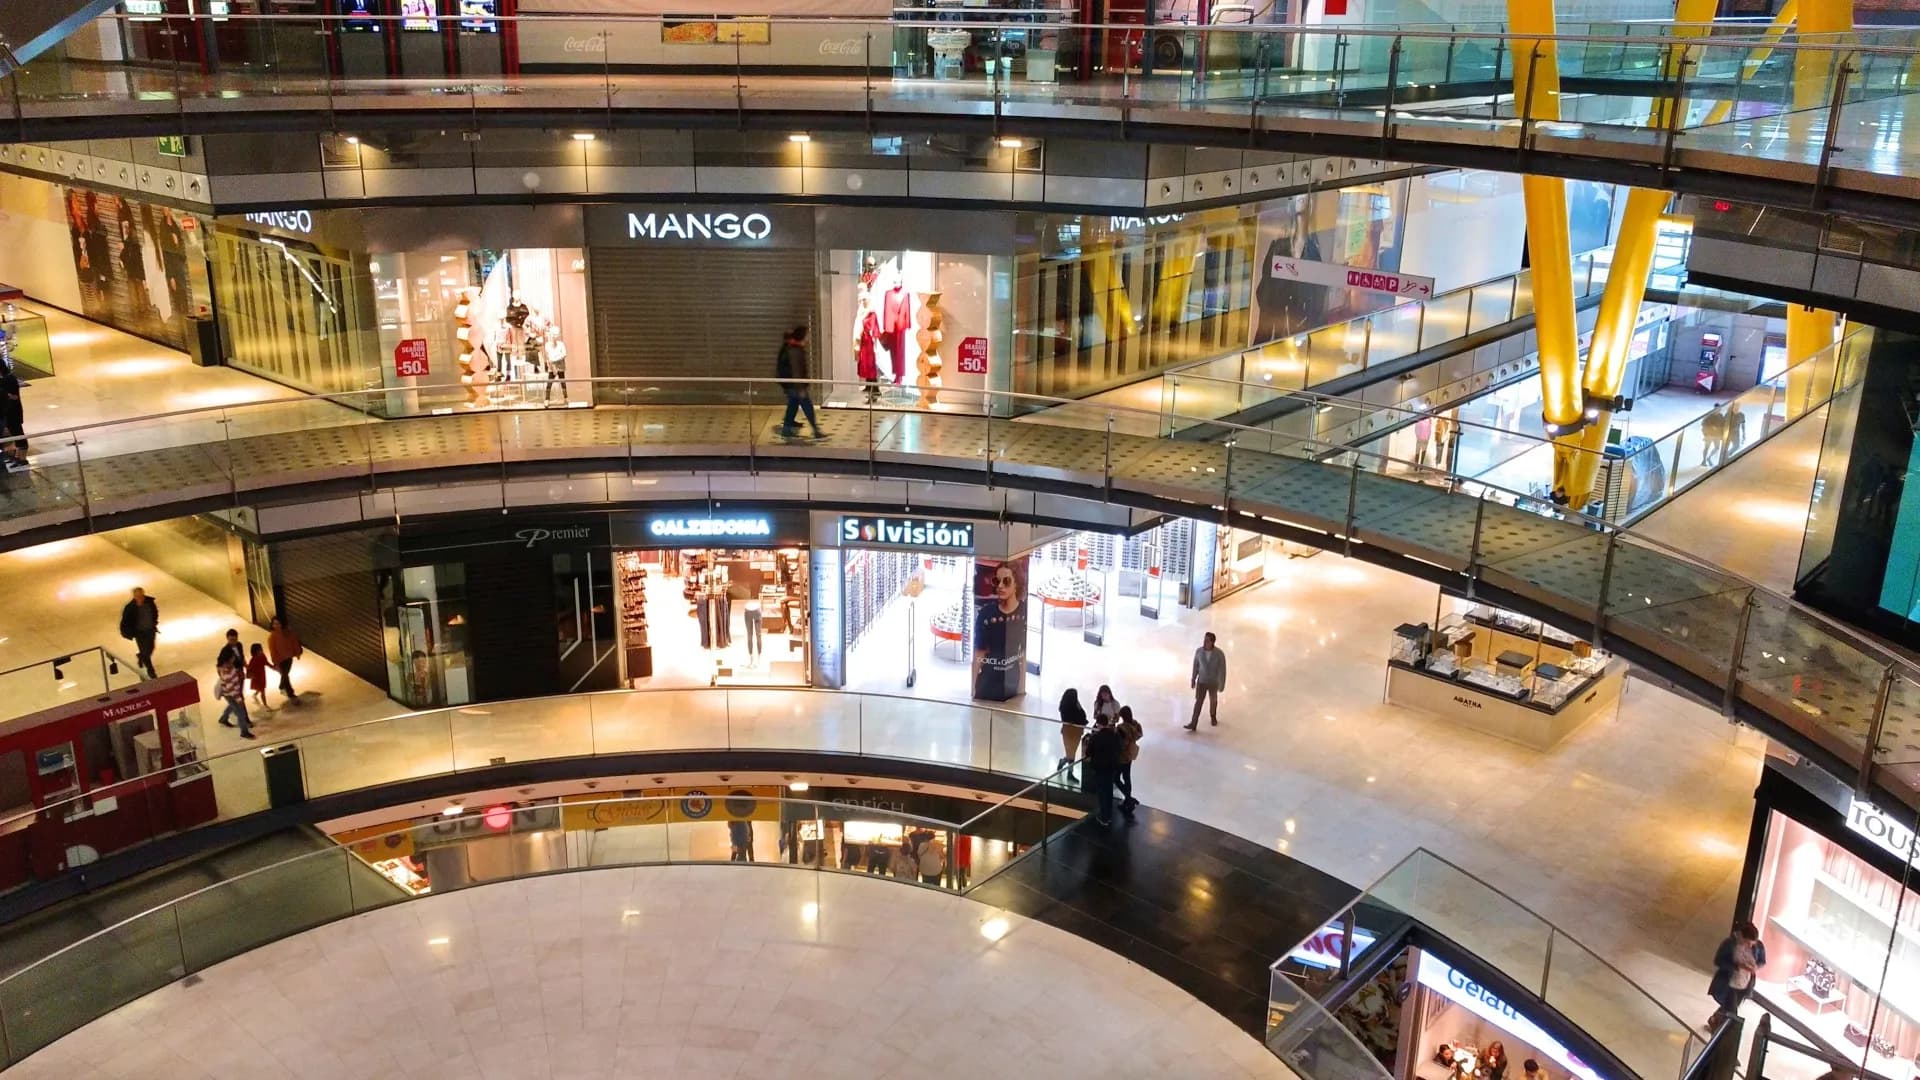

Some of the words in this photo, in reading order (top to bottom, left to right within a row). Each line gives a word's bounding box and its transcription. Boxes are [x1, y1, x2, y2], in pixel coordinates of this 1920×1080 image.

[628, 213, 771, 239] MANGO
[515, 525, 591, 548] Premier
[651, 519, 770, 536] CALZEDONIA
[1852, 804, 1920, 858] TOUS
